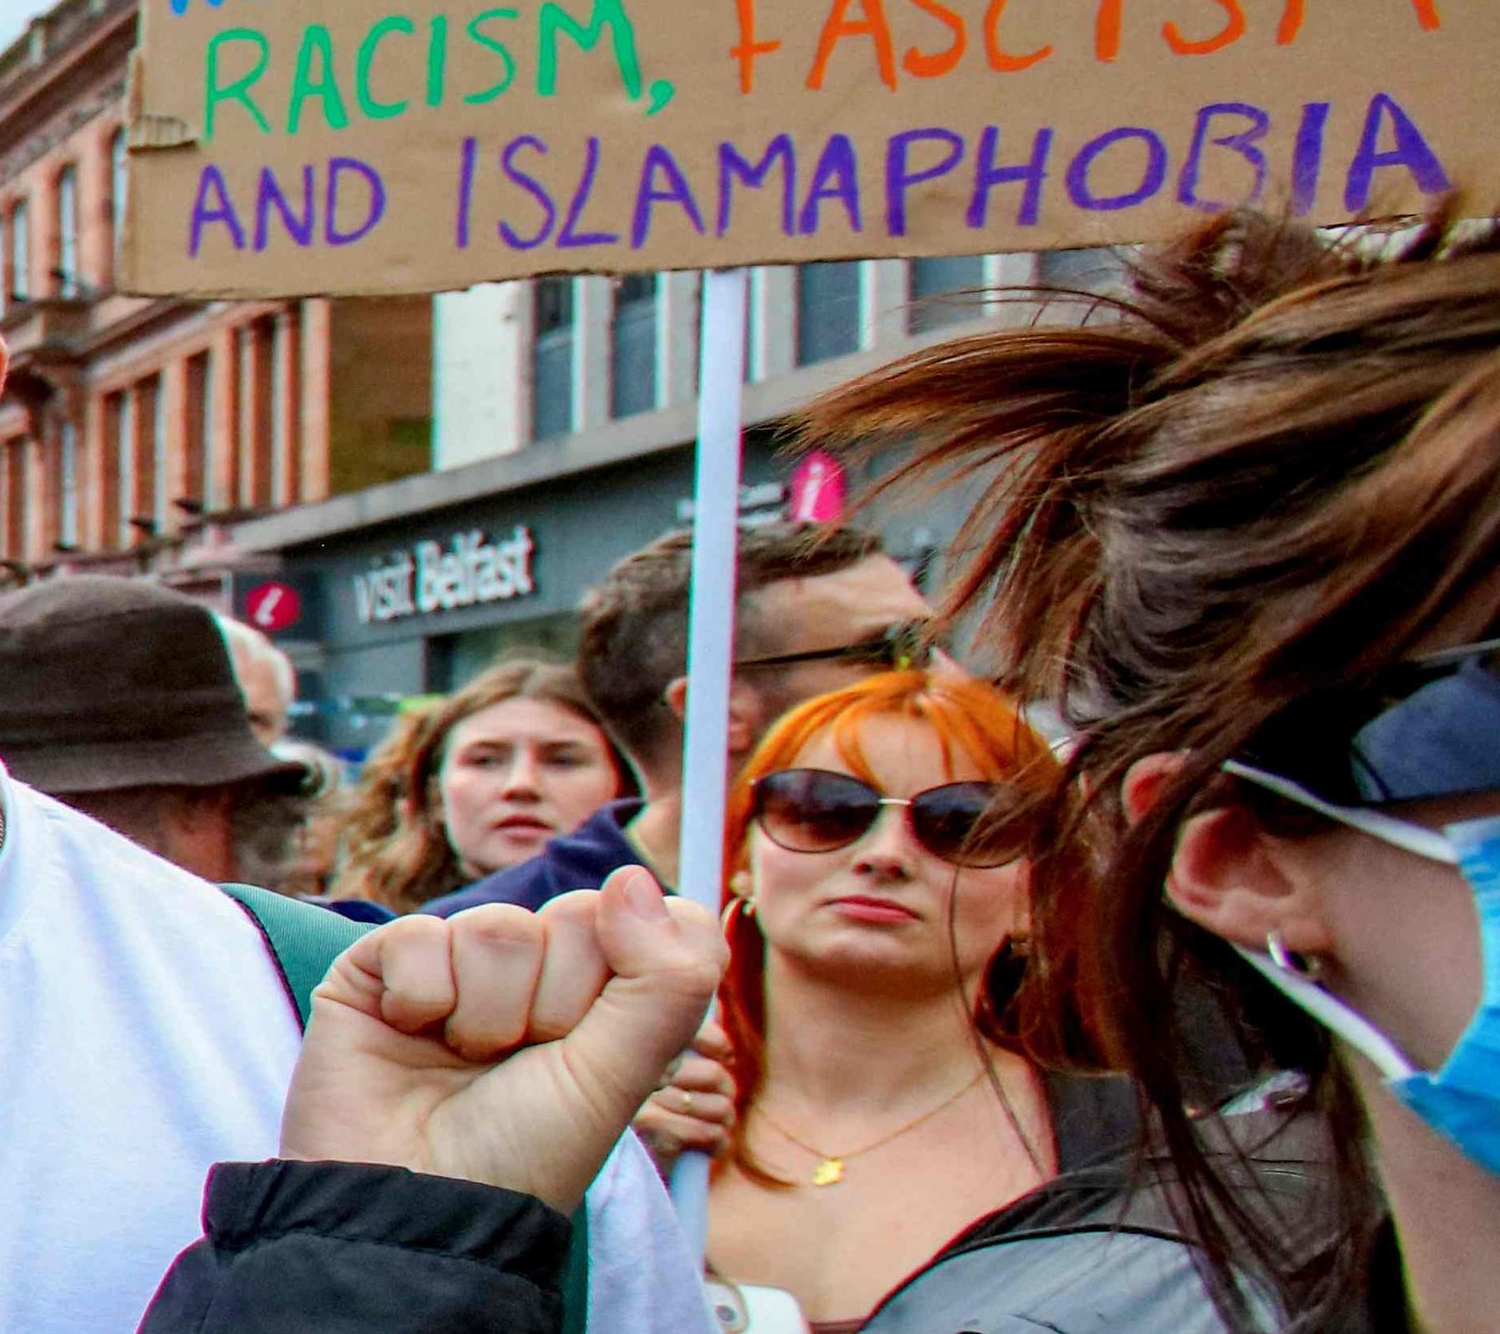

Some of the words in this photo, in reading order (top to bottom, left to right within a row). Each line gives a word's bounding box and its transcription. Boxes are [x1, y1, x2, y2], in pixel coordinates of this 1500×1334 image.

[187, 153, 387, 259] AND
[455, 91, 1456, 254] ISLAMAPHOBIA
[354, 550, 414, 623] visit
[415, 526, 533, 612] Belfast
